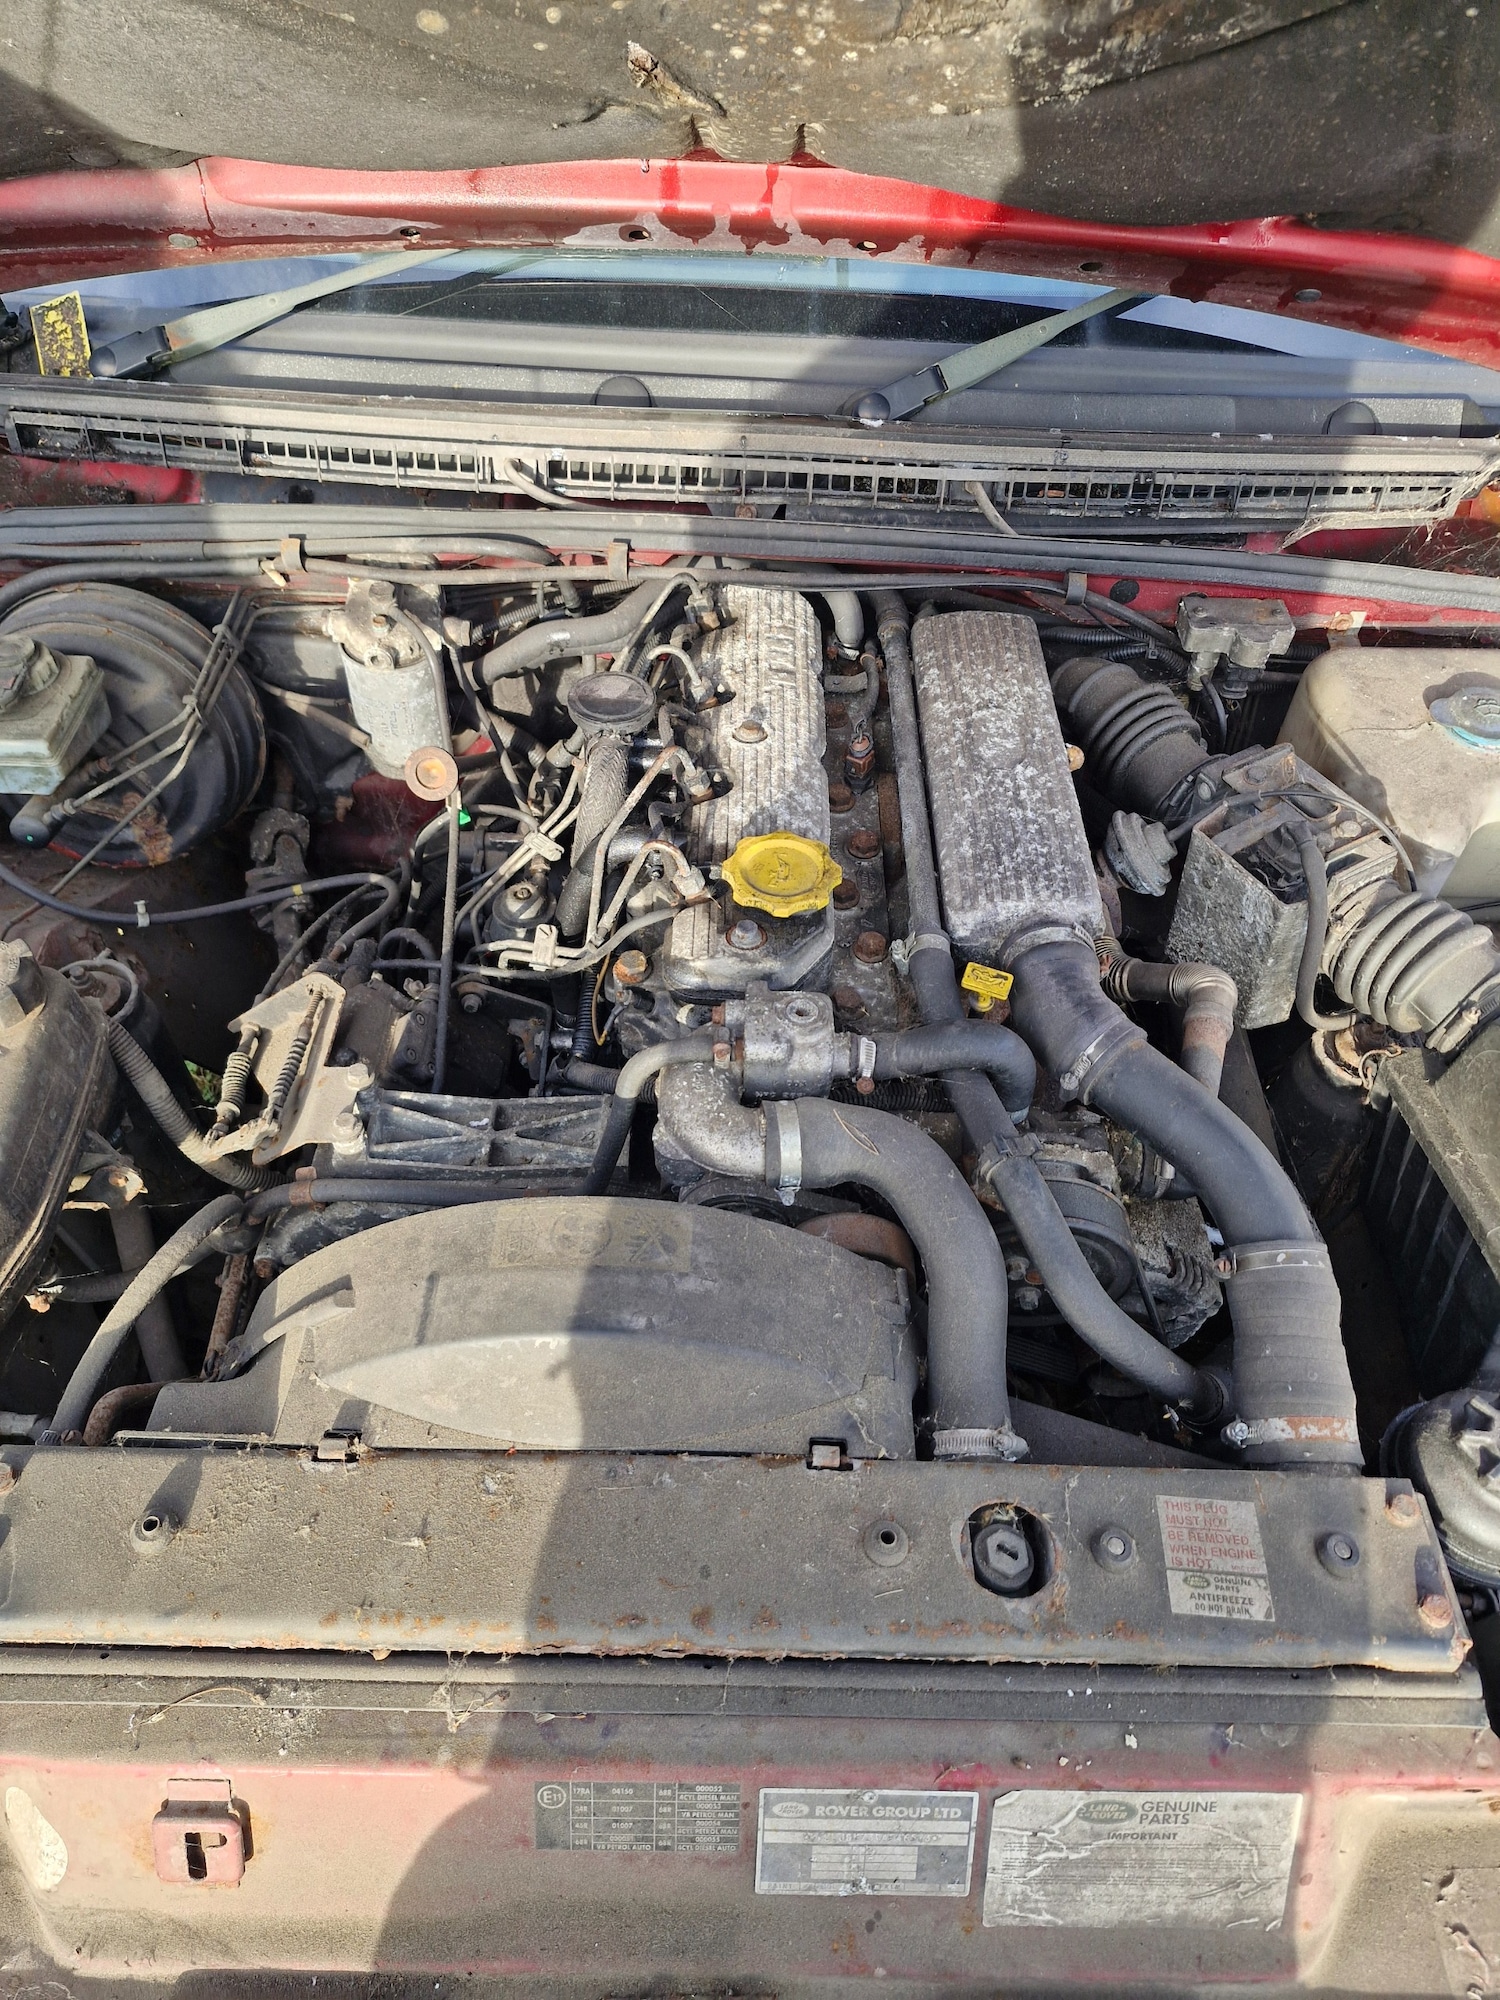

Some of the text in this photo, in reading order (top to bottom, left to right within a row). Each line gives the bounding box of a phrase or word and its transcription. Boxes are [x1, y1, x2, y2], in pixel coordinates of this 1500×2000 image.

[1164, 1500, 1229, 1515] THIS PLUG
[1165, 1515, 1199, 1527] MUST
[1167, 1530, 1249, 1545] BE REMOVED
[1169, 1544, 1258, 1560] WHEN ENGINE
[1171, 1557, 1213, 1569] IS HOT
[1213, 1577, 1252, 1586] GENUINE
[1214, 1585, 1241, 1593] PARTS
[1189, 1592, 1255, 1606] ANTIFREEZE
[1194, 1602, 1250, 1615] DO NOT DRAIN
[815, 1805, 962, 1820] ROVER GROUP LTD
[1141, 1801, 1218, 1813] GENUINE
[1139, 1812, 1190, 1825] PARTS
[1107, 1831, 1178, 1841] IMPORTANT
